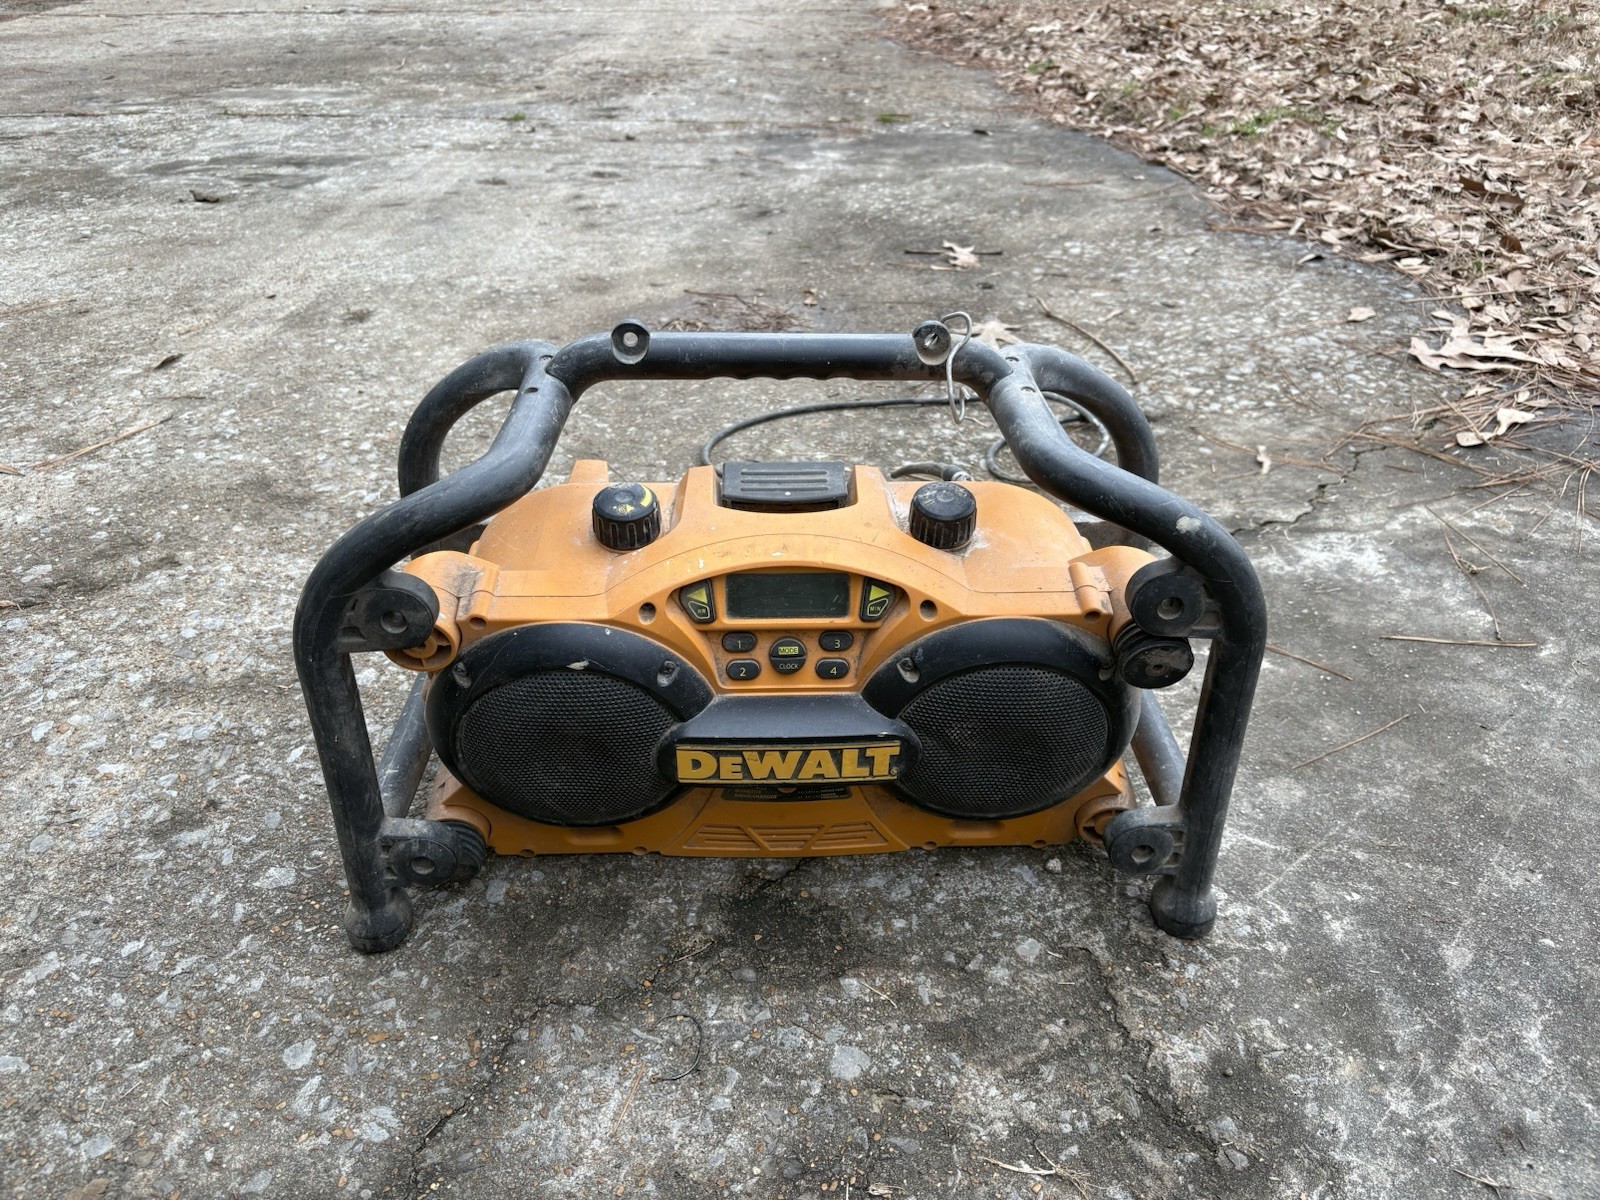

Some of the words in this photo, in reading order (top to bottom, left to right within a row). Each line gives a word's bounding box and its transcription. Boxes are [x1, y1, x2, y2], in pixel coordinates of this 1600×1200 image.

[737, 640, 741, 649] 1
[834, 639, 840, 648] 3
[740, 667, 746, 676] 2
[830, 666, 837, 675] 4
